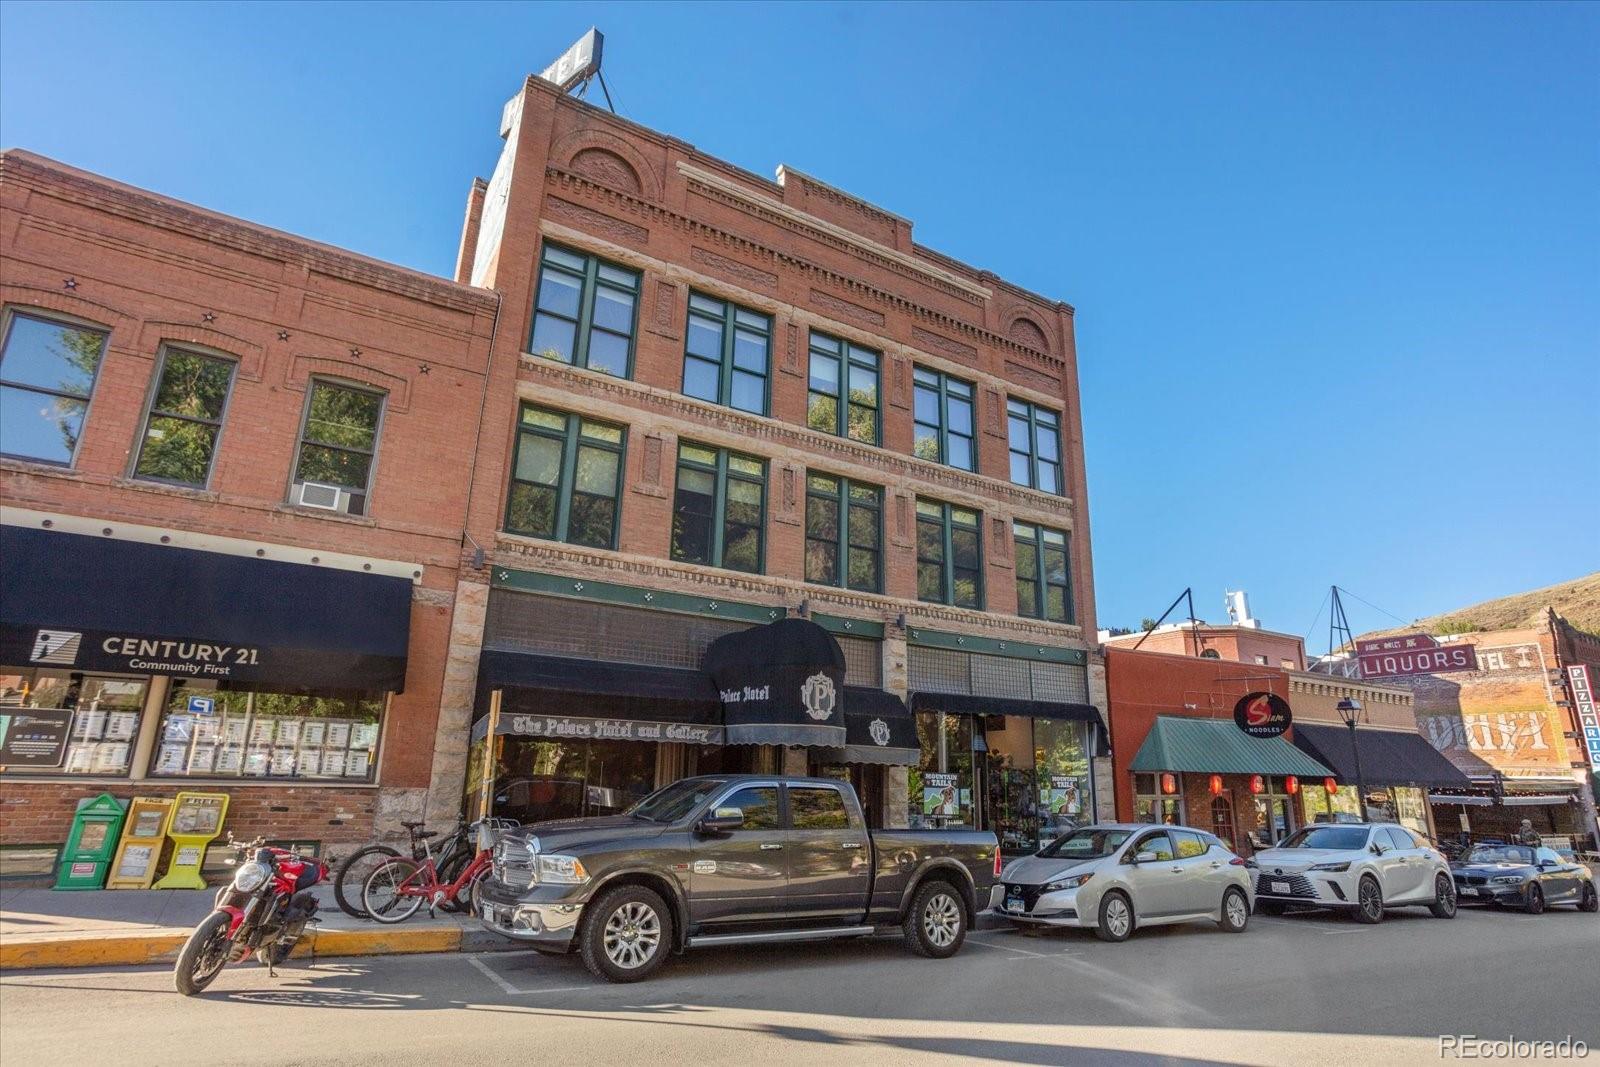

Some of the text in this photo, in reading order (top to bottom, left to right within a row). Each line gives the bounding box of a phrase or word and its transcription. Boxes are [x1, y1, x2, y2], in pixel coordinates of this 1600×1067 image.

[102, 637, 232, 662] CENTURY
[129, 659, 230, 675] Community First
[1362, 650, 1467, 674] LIQUORS
[743, 685, 770, 702] Hotel
[814, 685, 828, 709] P
[512, 716, 709, 743] The Palace Hotel and Gallery
[925, 773, 958, 781] MOUNTAIN
[931, 779, 953, 787] TAILS
